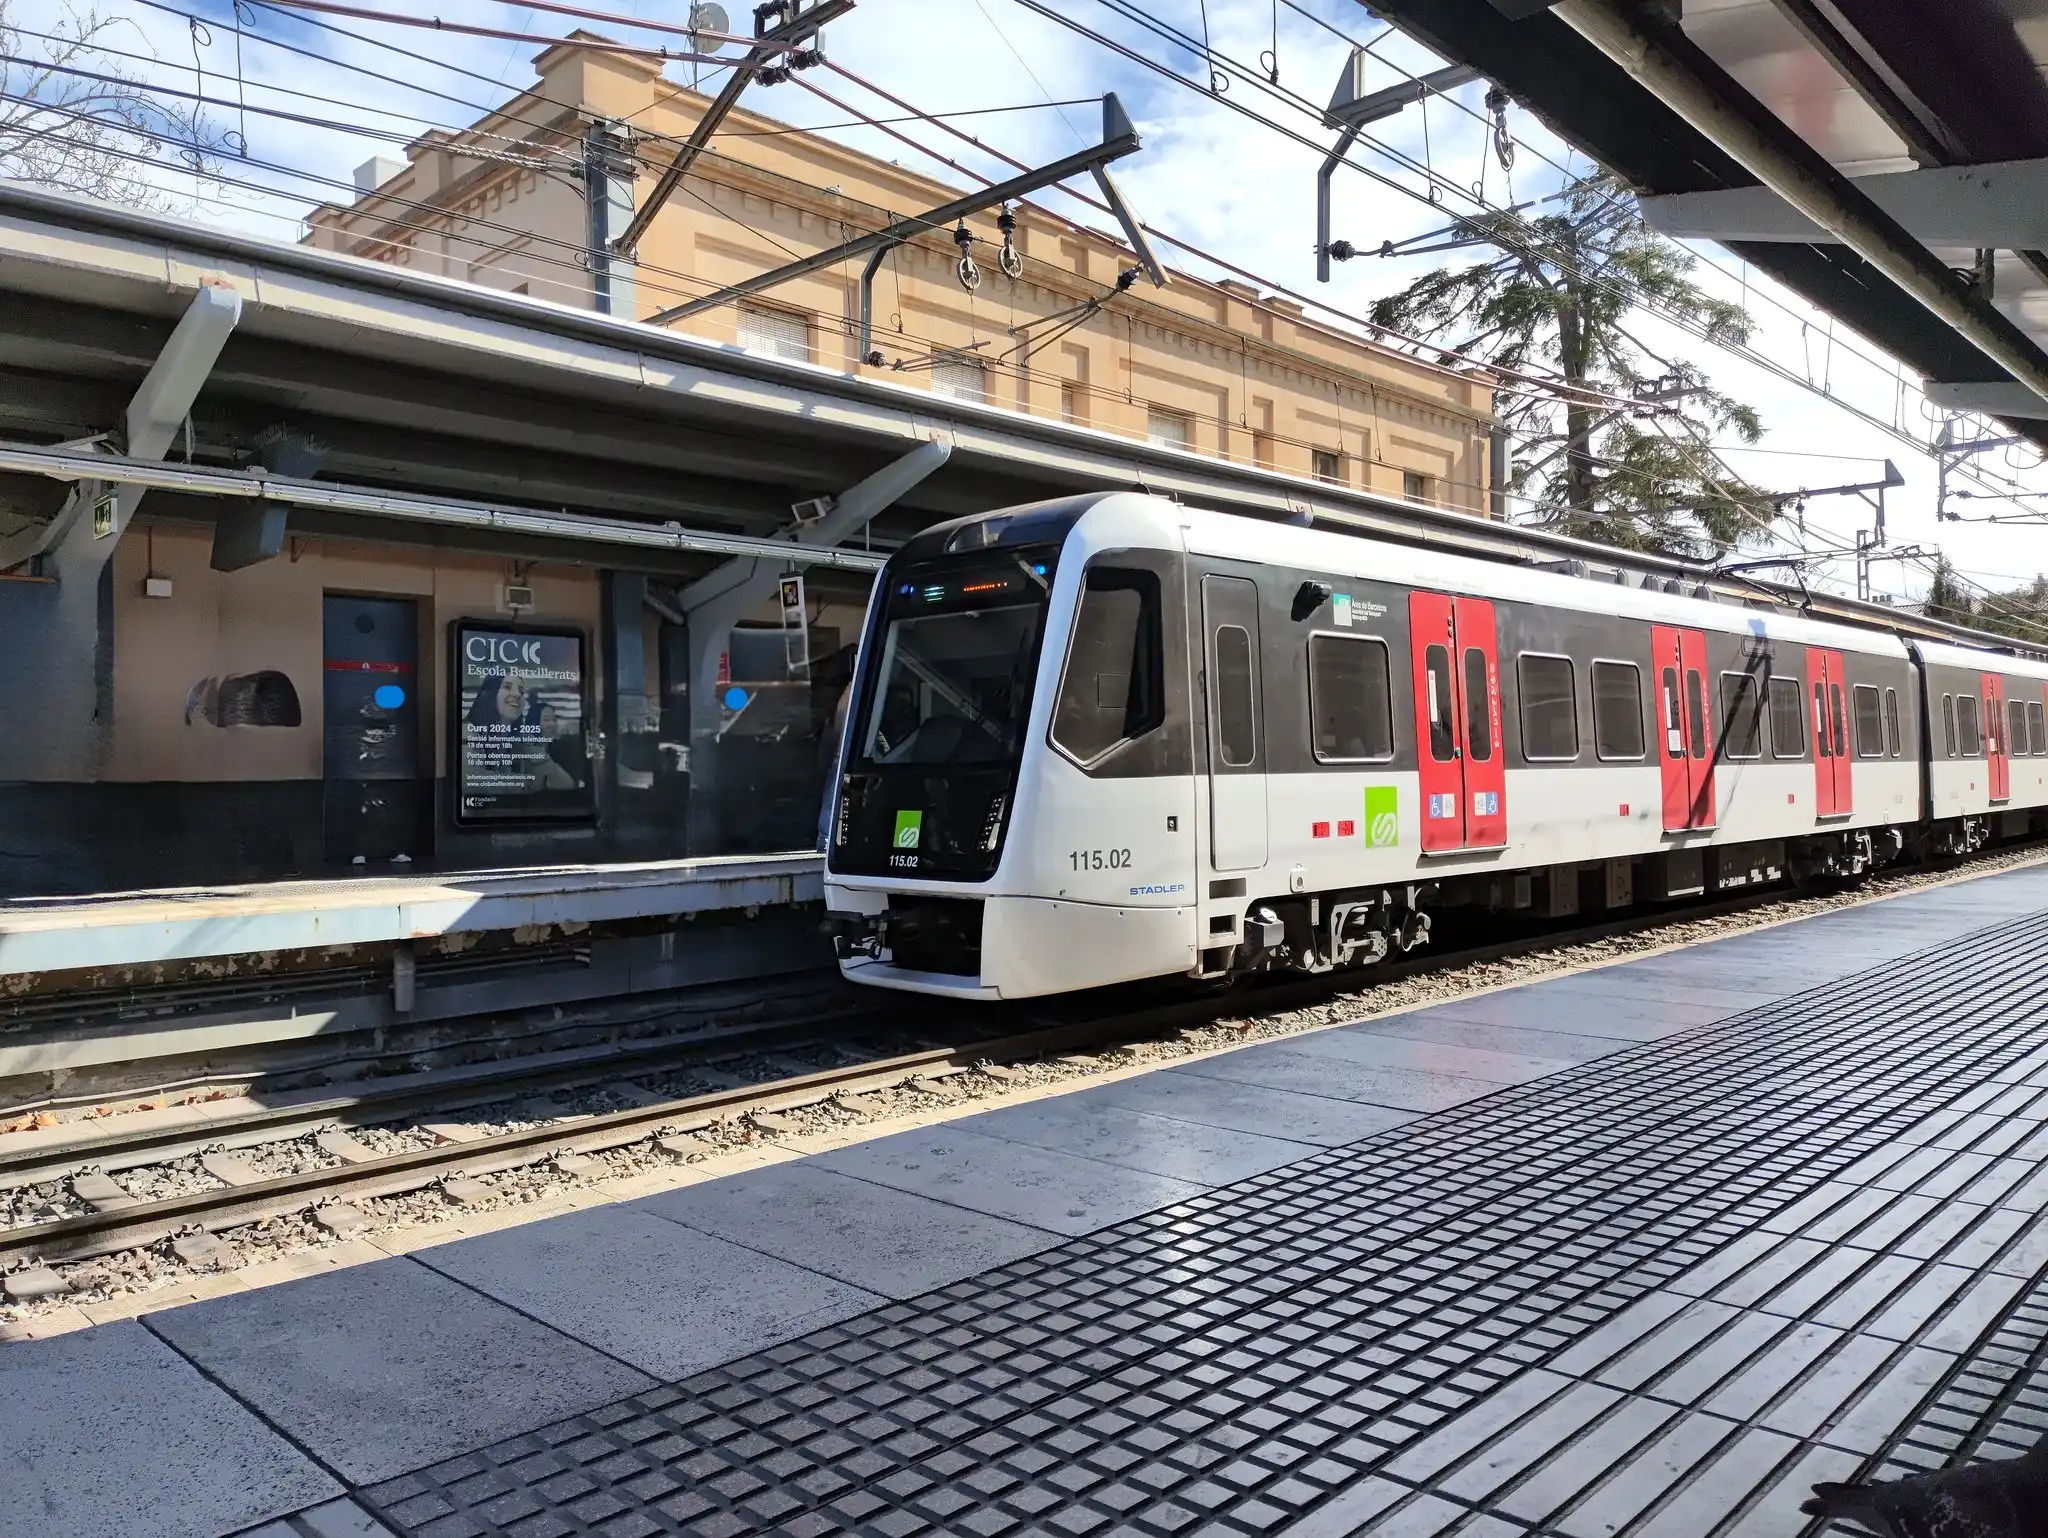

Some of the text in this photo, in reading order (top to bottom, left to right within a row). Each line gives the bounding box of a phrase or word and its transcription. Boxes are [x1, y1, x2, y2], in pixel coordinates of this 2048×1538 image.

[466, 637, 519, 664] CIC
[467, 664, 577, 680] Escola Batxillerats
[467, 724, 488, 733] Curs
[489, 724, 512, 733] 2024
[519, 725, 541, 733] 2025
[890, 854, 919, 867] 115.02
[1069, 848, 1132, 872] 115.02
[1129, 884, 1186, 895] STADLER
